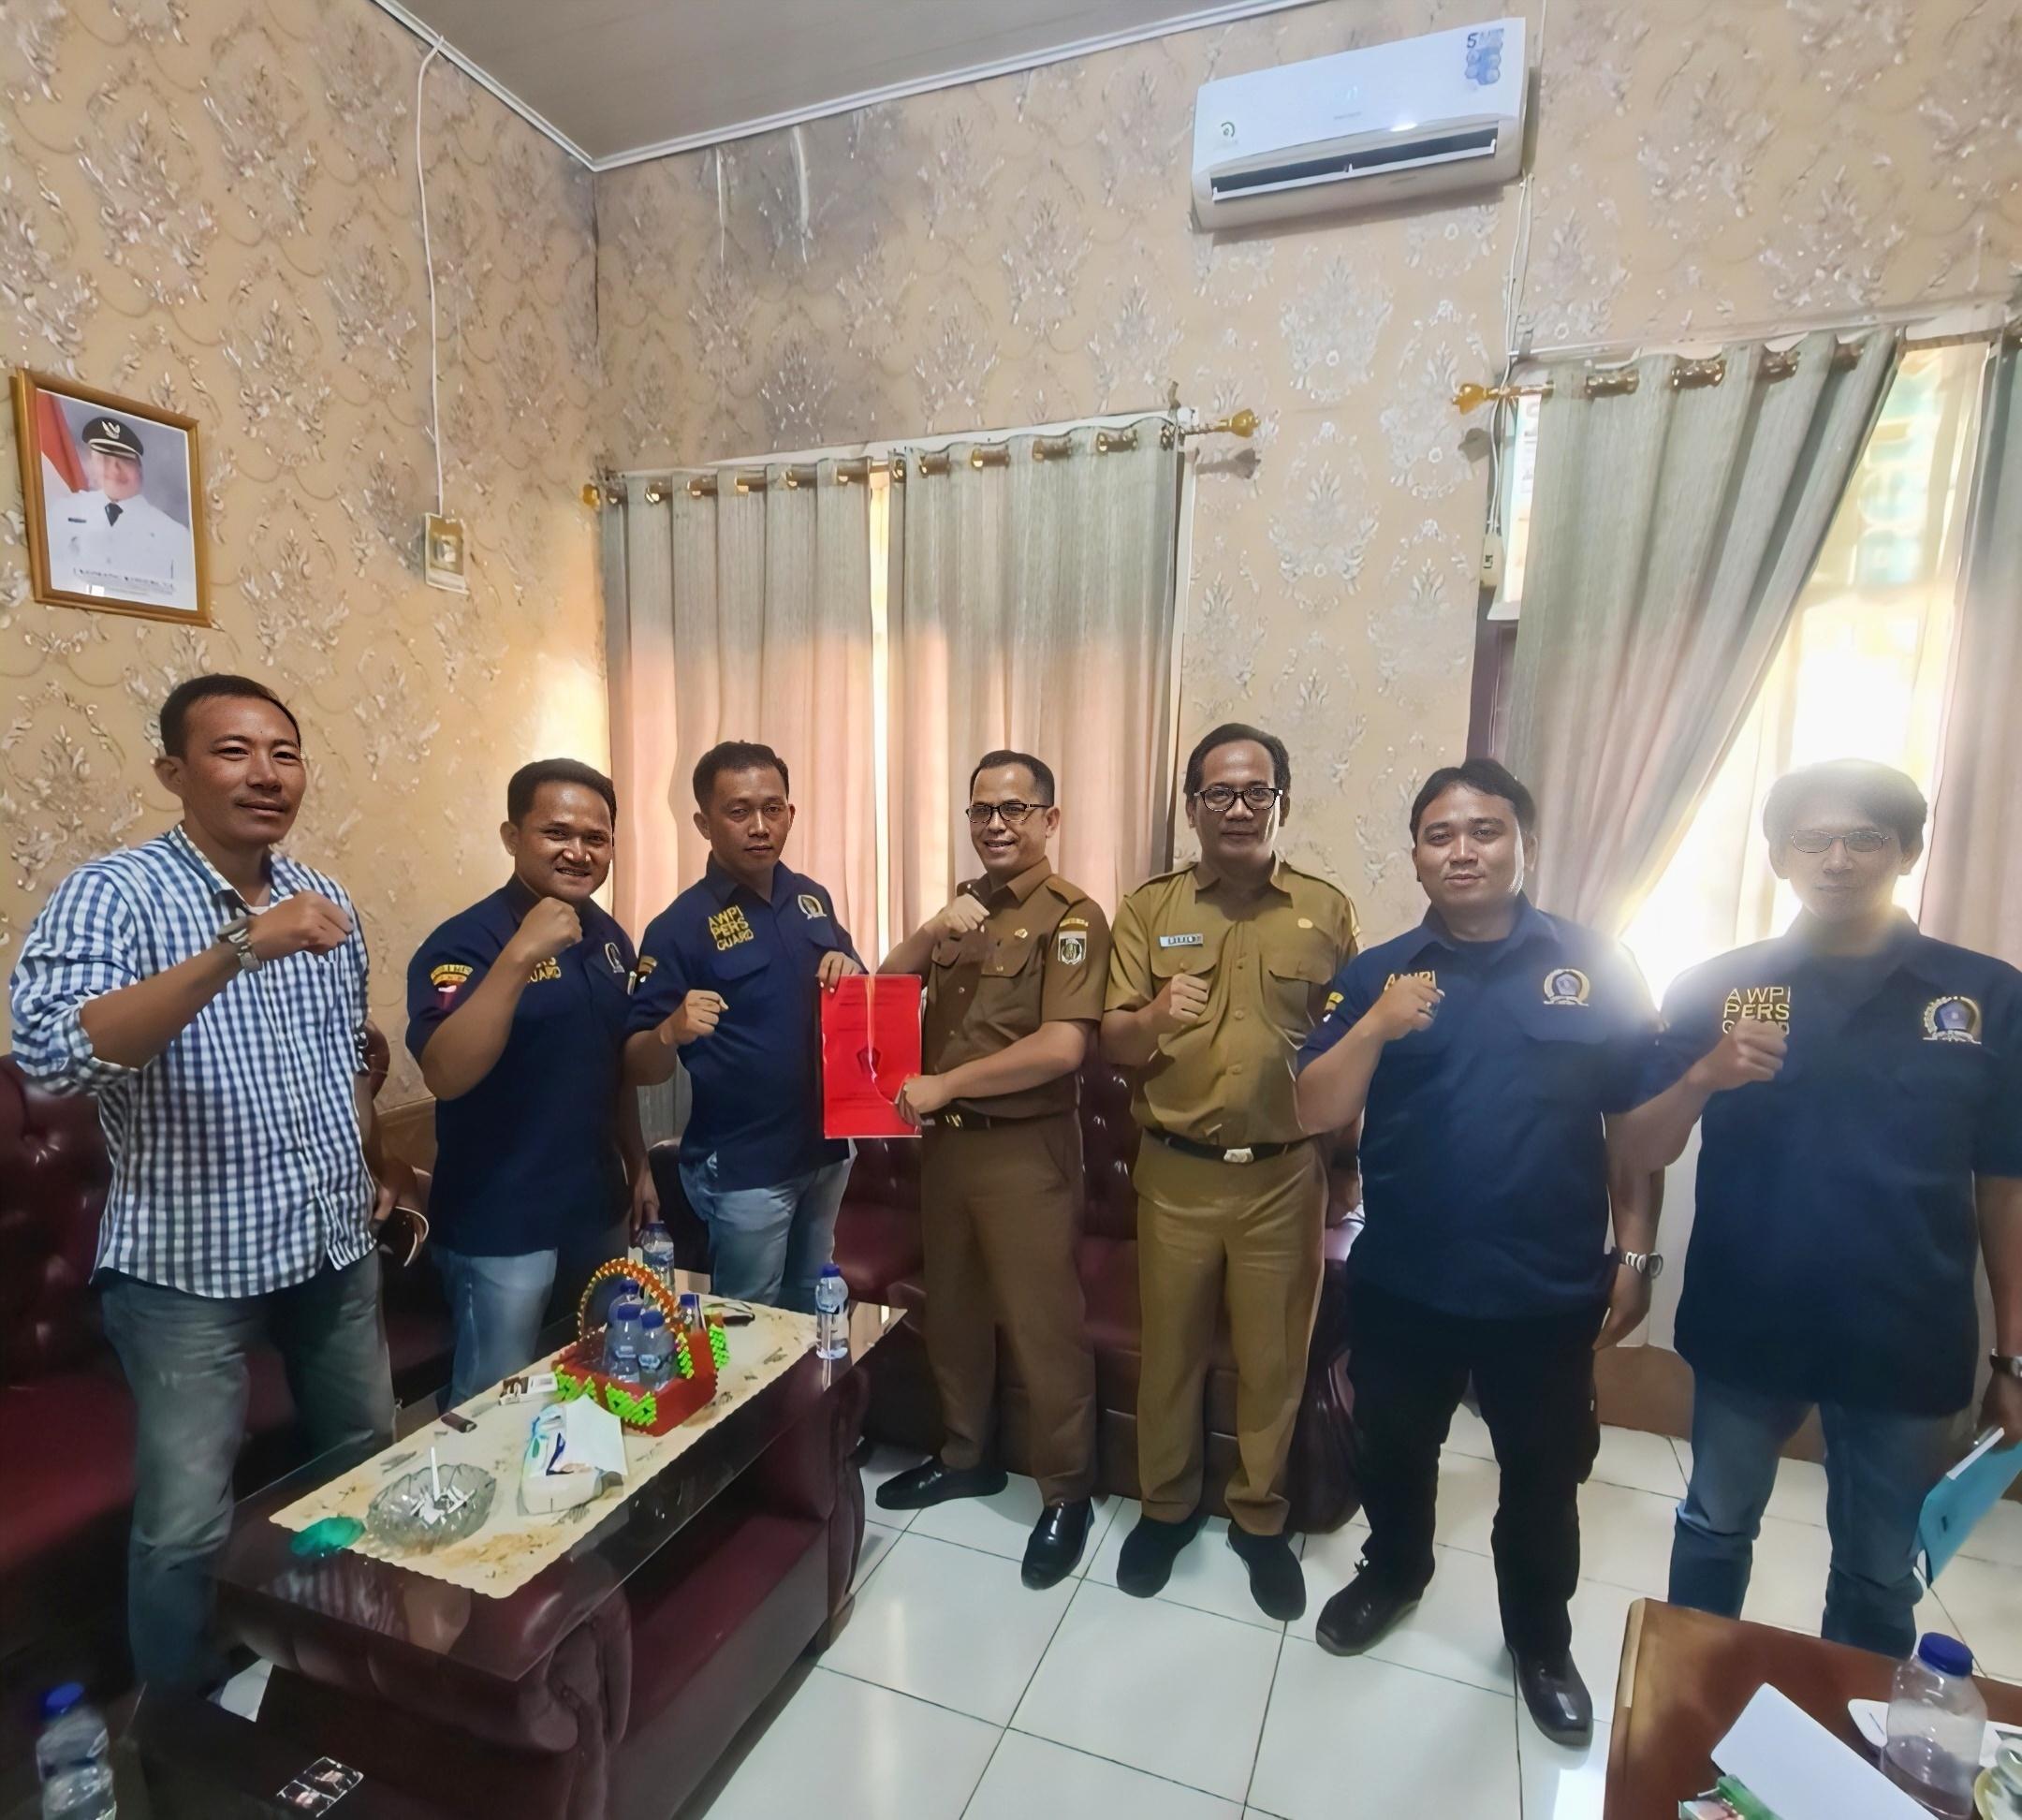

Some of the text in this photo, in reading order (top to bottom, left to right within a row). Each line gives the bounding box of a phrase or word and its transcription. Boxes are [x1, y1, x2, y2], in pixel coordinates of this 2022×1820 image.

[708, 904, 745, 928] AWPI
[1725, 986, 1792, 1005] AWPI
[1723, 1003, 1791, 1020] PERS
